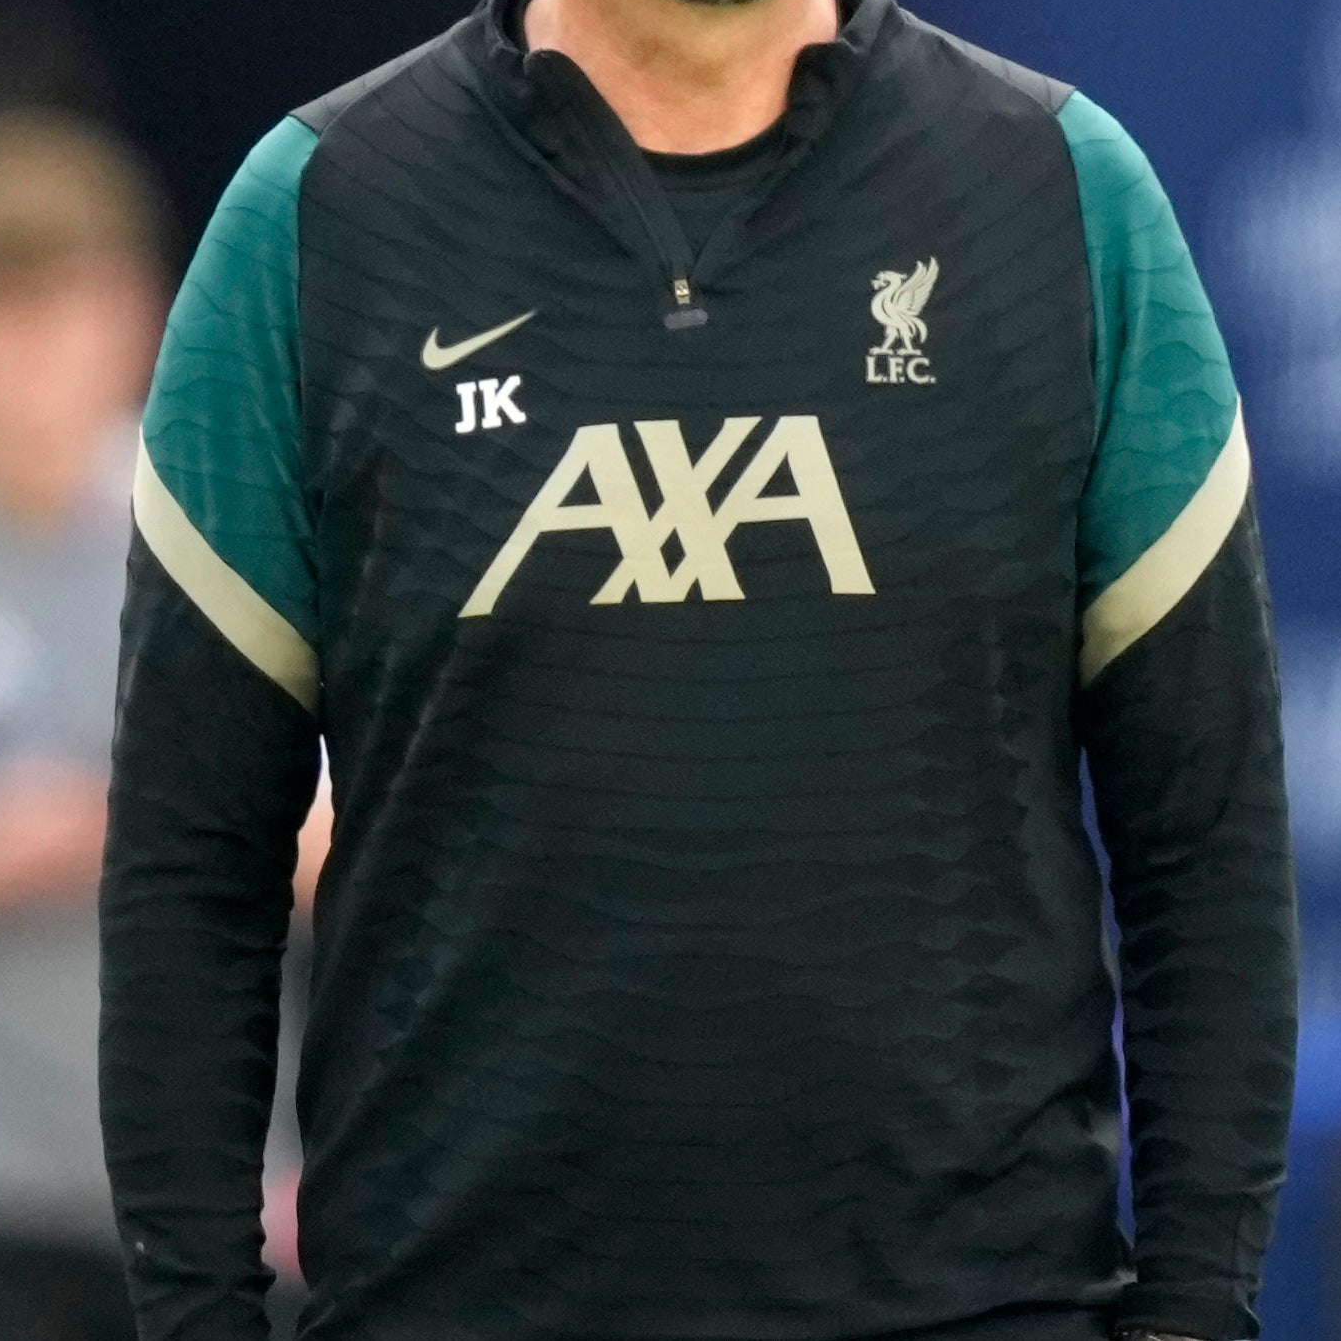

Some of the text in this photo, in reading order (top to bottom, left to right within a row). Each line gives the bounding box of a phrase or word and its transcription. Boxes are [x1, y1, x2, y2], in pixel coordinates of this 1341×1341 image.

[865, 356, 936, 384] L.F.C.
[455, 375, 526, 433] JK
[459, 415, 876, 617] AXA
